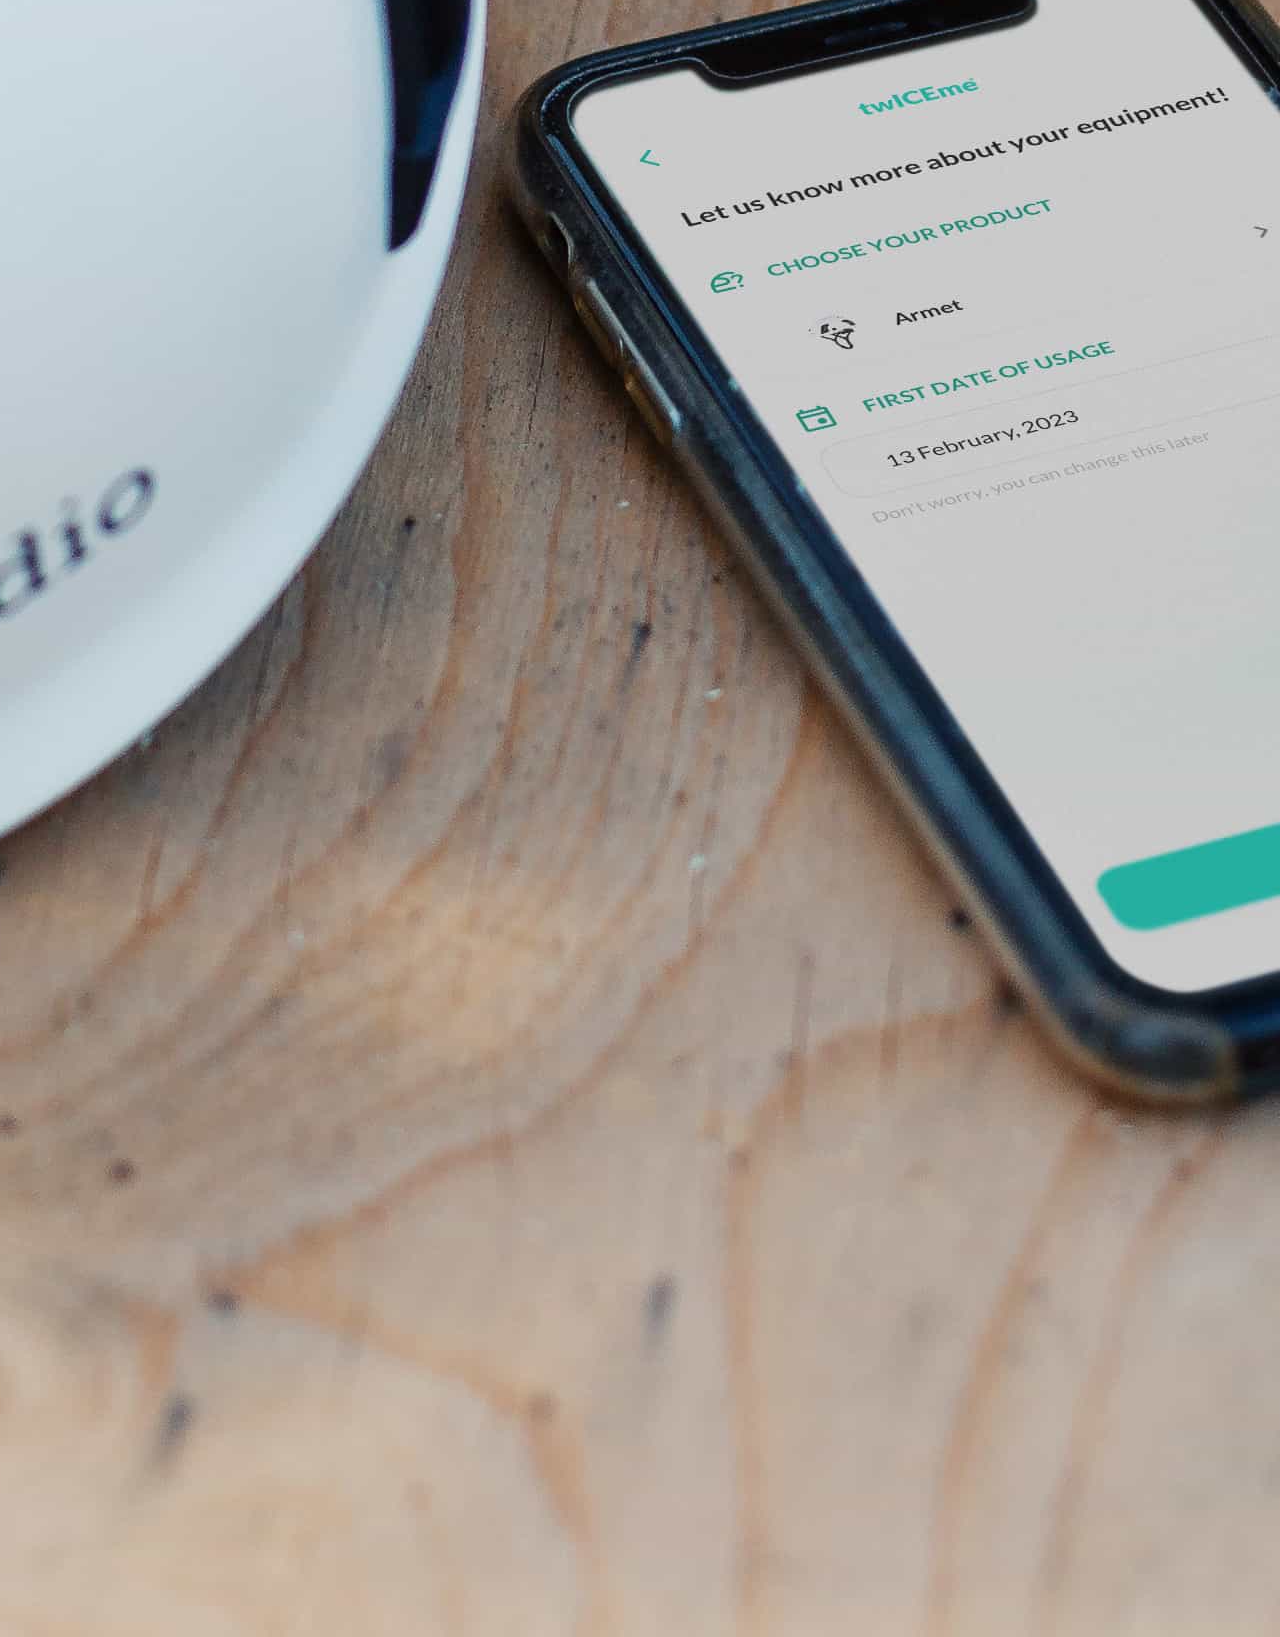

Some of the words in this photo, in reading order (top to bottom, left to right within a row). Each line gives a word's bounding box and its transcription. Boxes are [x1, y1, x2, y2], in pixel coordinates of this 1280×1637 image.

[858, 78, 979, 115] twICEme
[681, 205, 730, 227] Let
[733, 198, 766, 215] us
[766, 179, 844, 207] know
[849, 162, 922, 188] more
[926, 140, 1007, 171] about
[1008, 127, 1070, 153] your
[1076, 87, 1230, 134] equipment!
[767, 244, 868, 276] CHOOSE
[867, 227, 938, 252] YOUR
[939, 199, 1052, 236] PRODUCT
[895, 299, 964, 326] Armet
[862, 386, 928, 412] FIRST
[930, 370, 997, 397] DATE
[998, 361, 1031, 378] OF
[1034, 341, 1116, 369] USAGE
[887, 450, 916, 467] 13
[917, 428, 1022, 460] February,
[1022, 410, 1080, 434] 2023
[872, 502, 927, 524] Don't
[927, 488, 990, 512] worry,
[991, 478, 1026, 496] you
[1028, 468, 1061, 485] can
[1063, 451, 1130, 476] change
[1131, 443, 1166, 460] this
[1168, 431, 1210, 450] later
